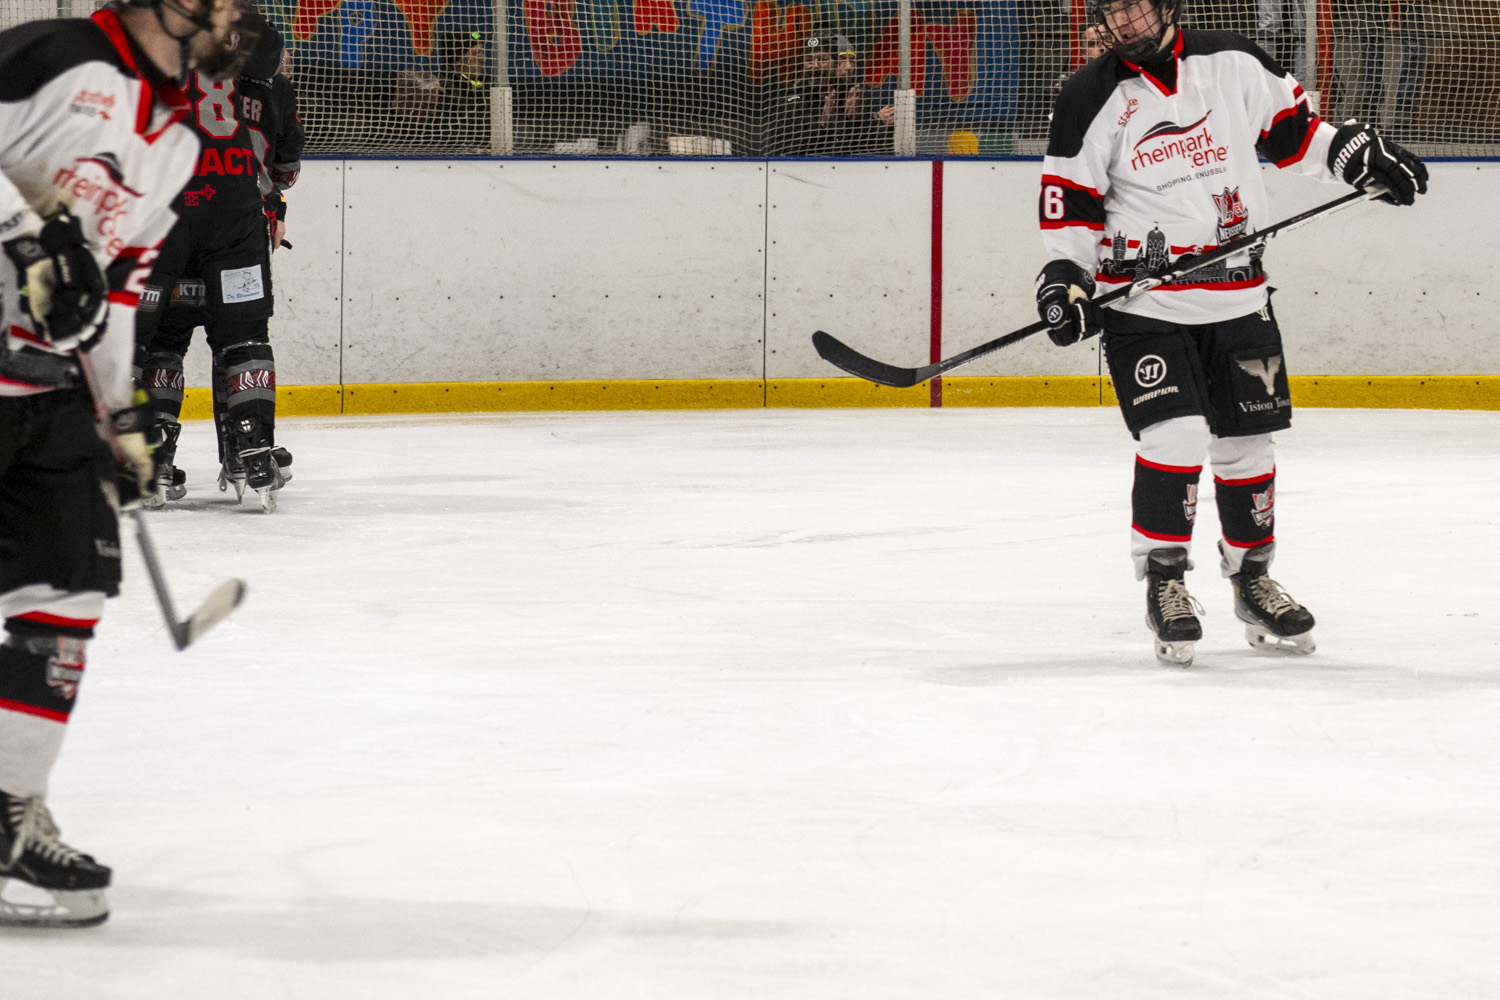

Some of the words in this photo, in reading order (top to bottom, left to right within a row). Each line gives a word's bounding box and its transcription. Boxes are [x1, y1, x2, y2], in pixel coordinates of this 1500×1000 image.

[241, 95, 262, 122] ER
[139, 289, 160, 302] TM
[1133, 385, 1180, 406] WARRIOR
[1238, 400, 1274, 413] Vision
